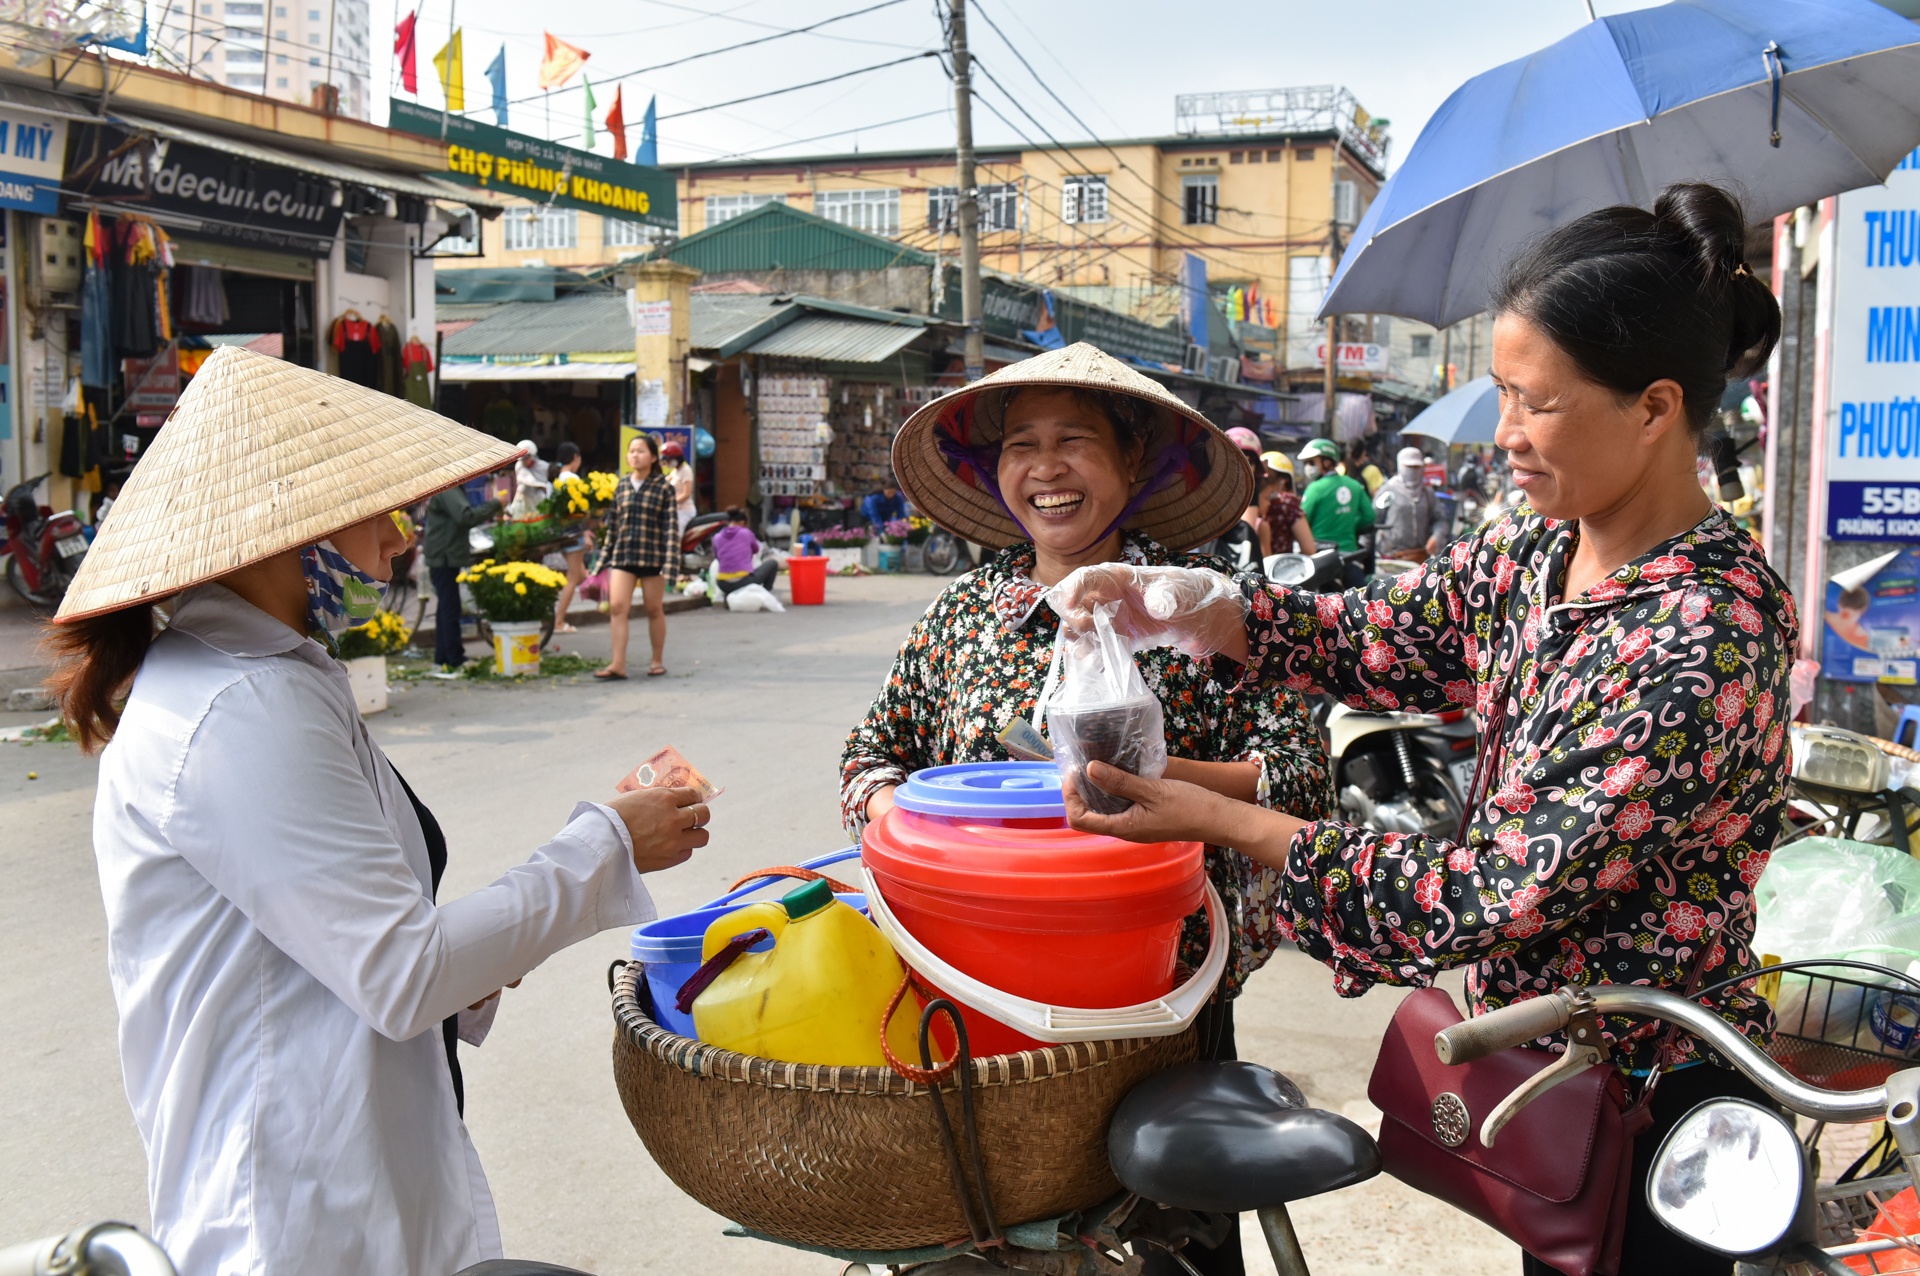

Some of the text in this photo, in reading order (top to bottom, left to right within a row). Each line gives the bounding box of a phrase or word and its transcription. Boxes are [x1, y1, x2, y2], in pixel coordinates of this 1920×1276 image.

[14, 122, 53, 162] MỸ
[448, 144, 651, 215] CHỢ PHÙNG KHOANG
[1864, 208, 1920, 268] THU
[1862, 486, 1920, 515] 55B
[1886, 519, 1920, 537] KHO
